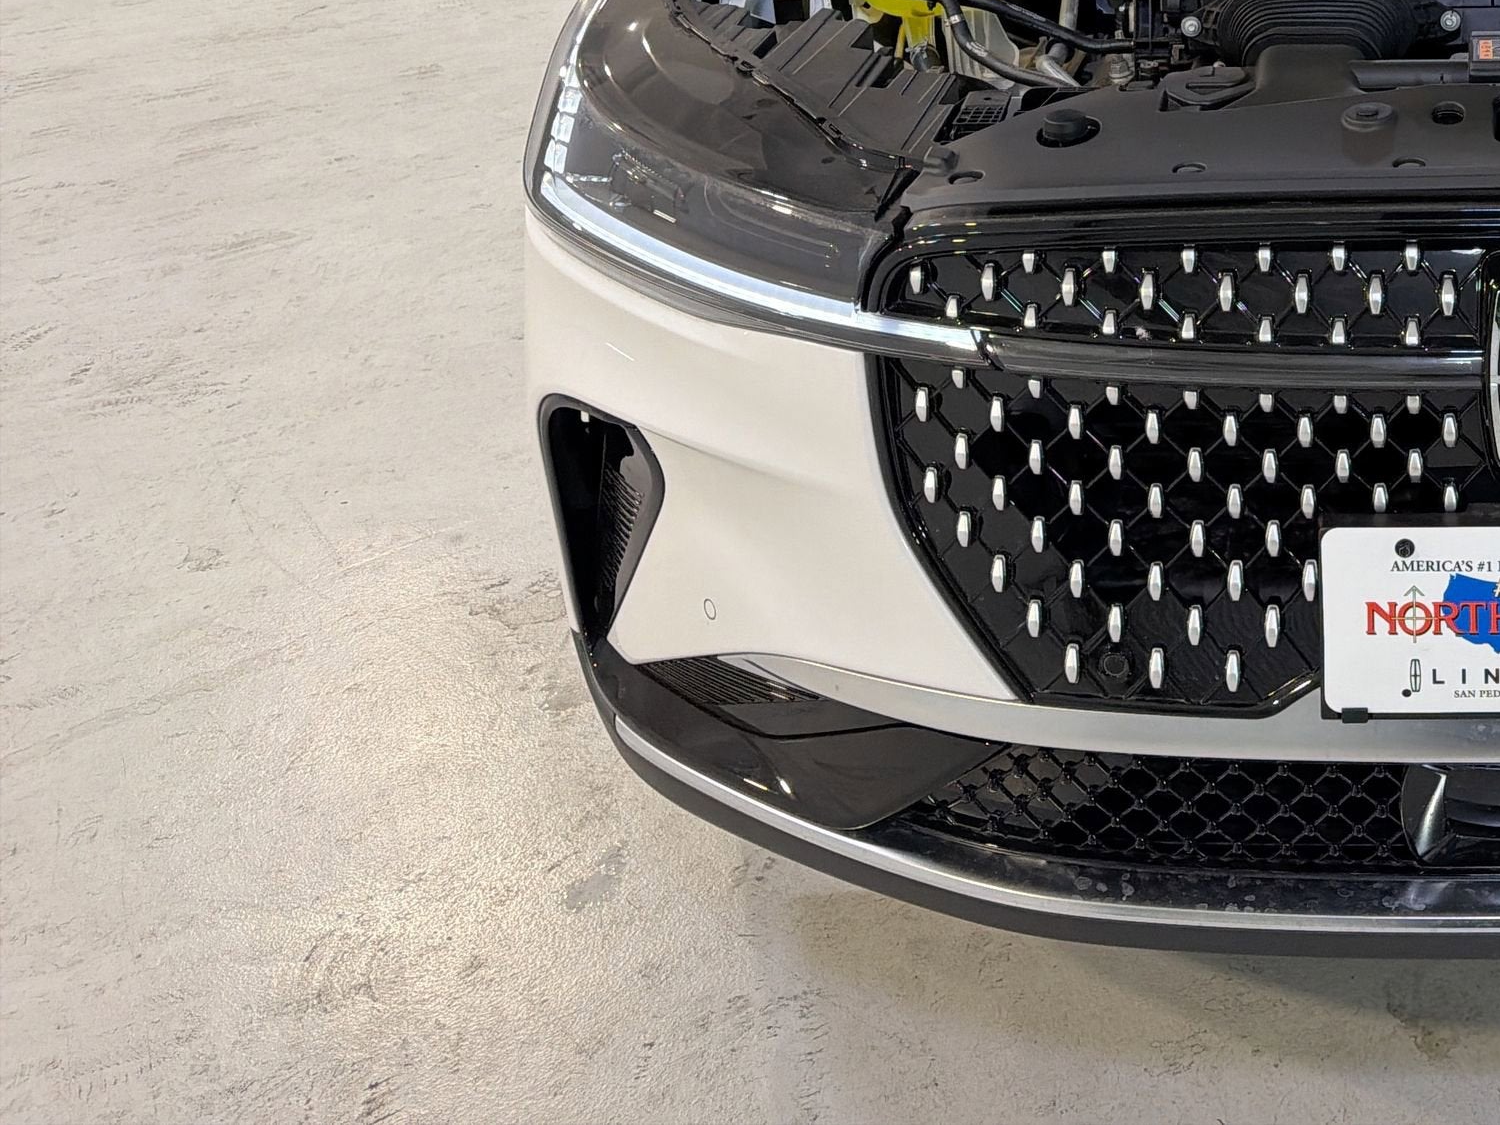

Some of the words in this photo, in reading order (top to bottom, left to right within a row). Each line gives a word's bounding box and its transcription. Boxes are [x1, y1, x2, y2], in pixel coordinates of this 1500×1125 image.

[1390, 560, 1473, 572] AMERICA'S
[1477, 560, 1492, 572] #1
[1454, 689, 1476, 698] SAN
